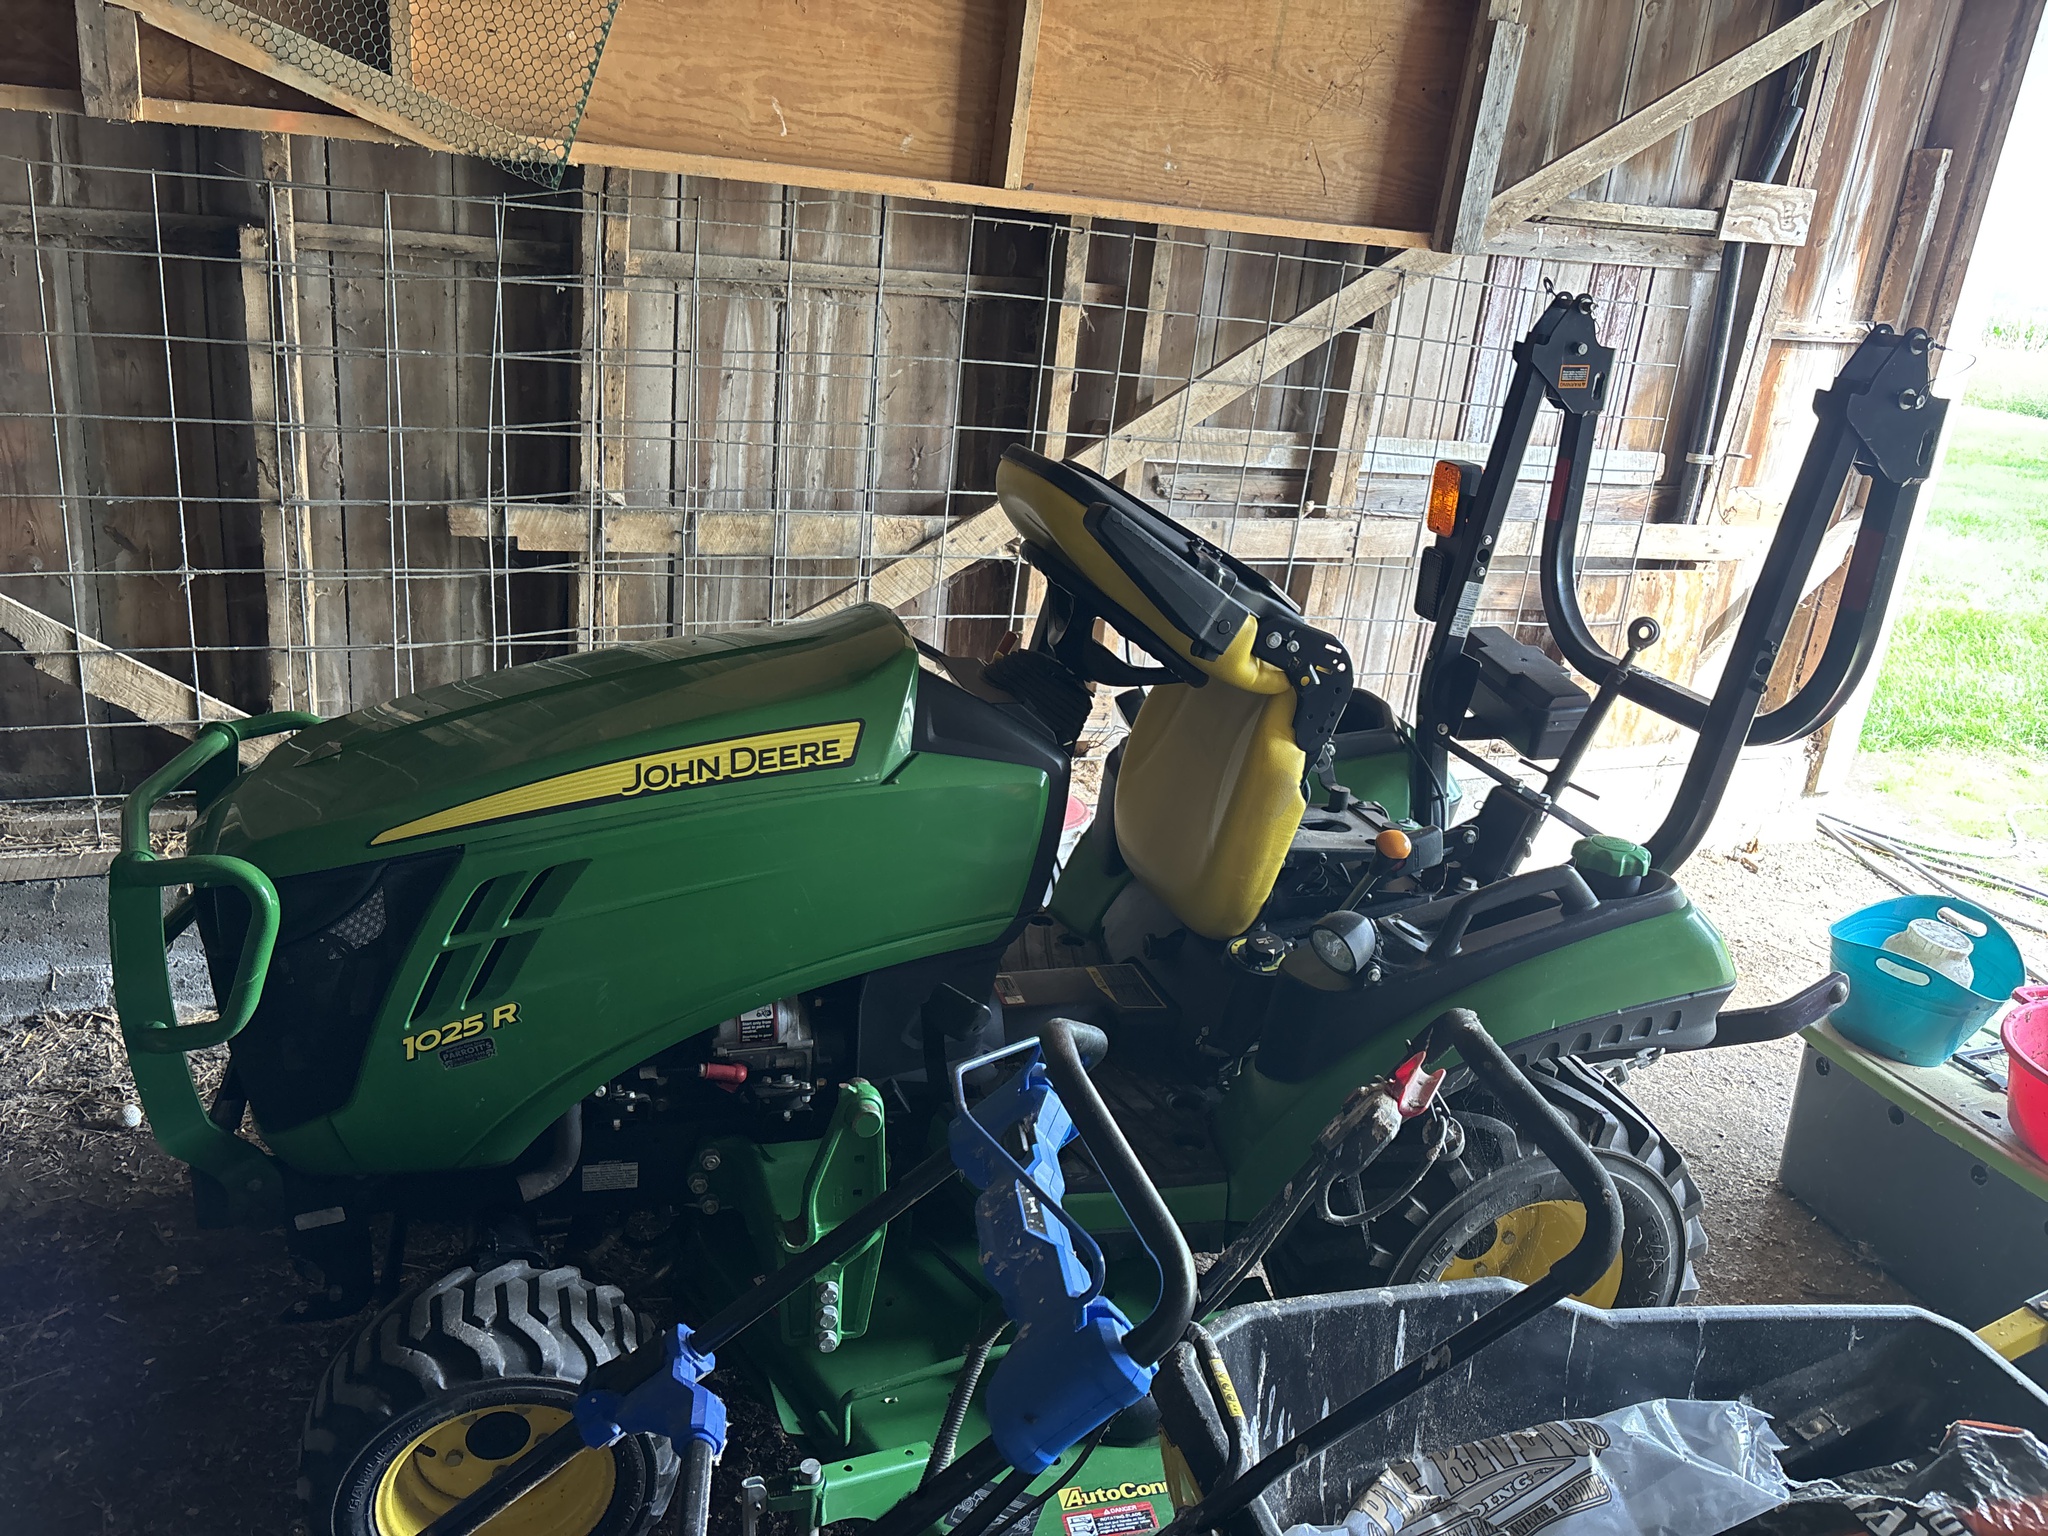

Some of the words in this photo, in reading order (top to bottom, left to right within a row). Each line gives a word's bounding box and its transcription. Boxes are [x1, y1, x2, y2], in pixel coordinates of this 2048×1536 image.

[621, 756, 721, 795] JOHN
[730, 739, 841, 775] DEERE
[402, 1013, 485, 1061] 1025
[492, 1002, 521, 1030] R
[1110, 1505, 1137, 1514] DANGER
[1552, 1473, 1609, 1512] BEDDING
